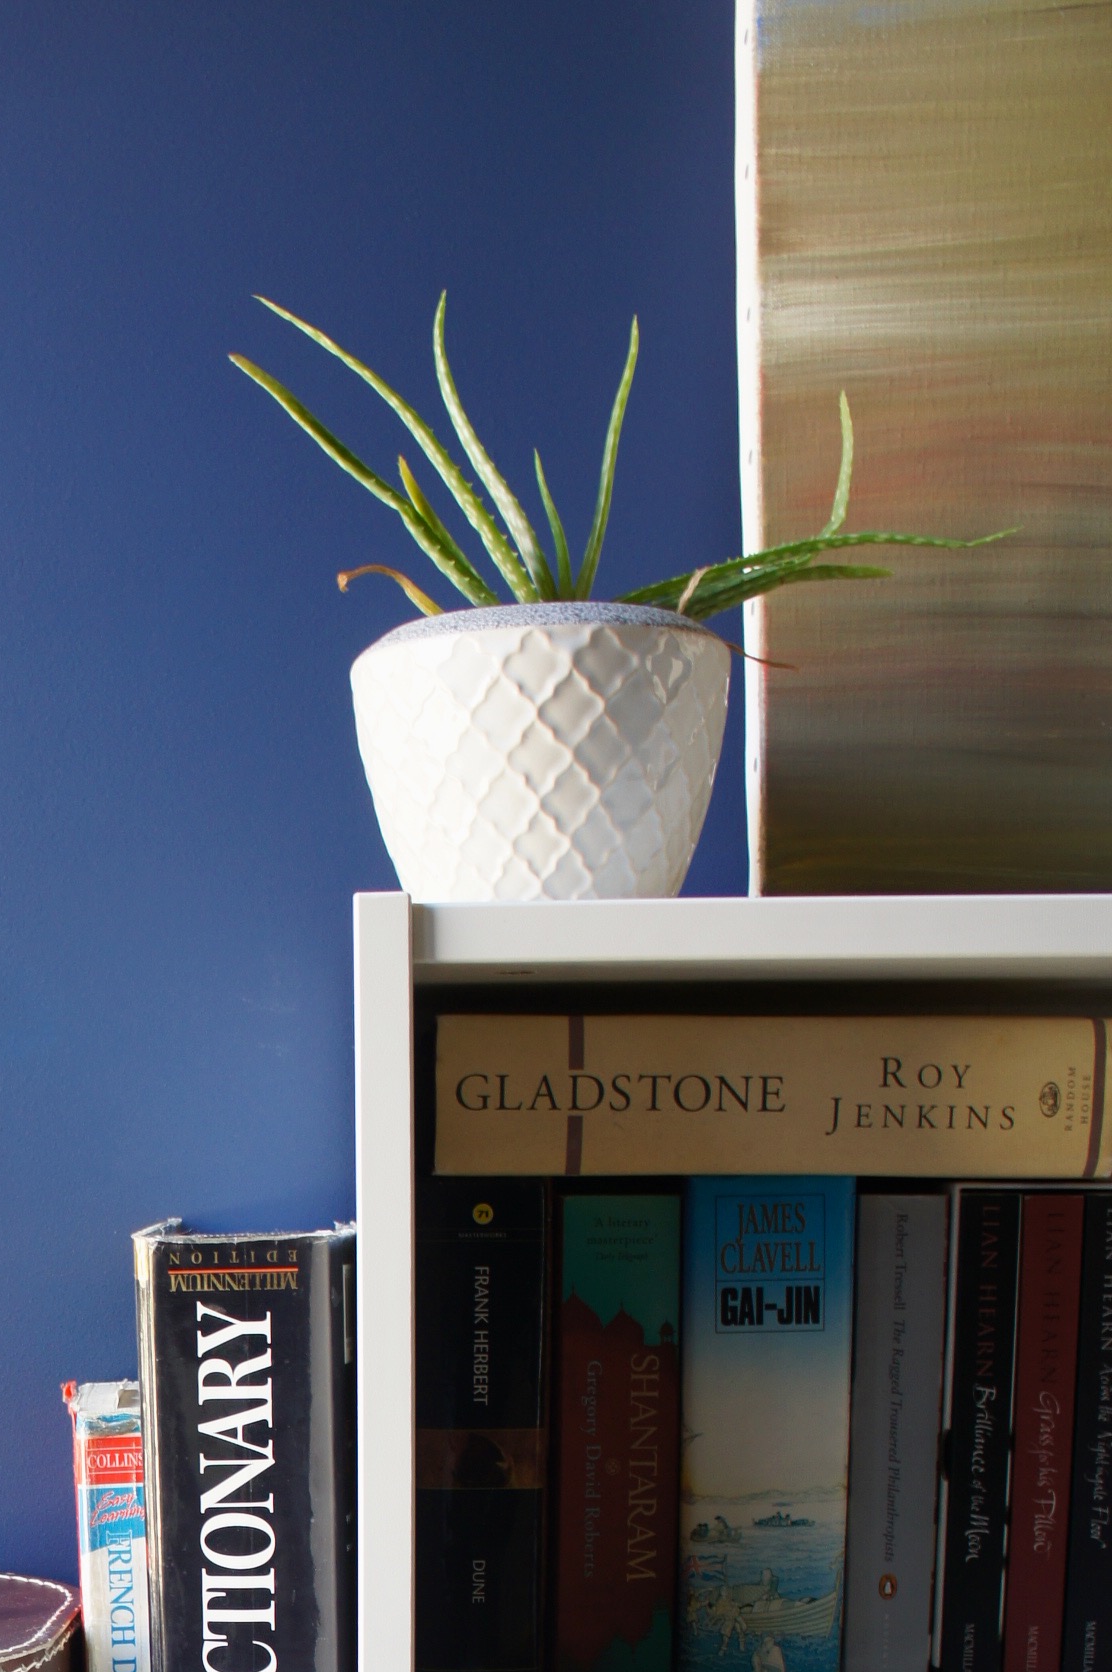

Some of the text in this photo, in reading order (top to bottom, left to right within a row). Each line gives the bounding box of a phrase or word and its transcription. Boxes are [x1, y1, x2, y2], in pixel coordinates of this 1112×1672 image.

[455, 1073, 788, 1113] GLADSTONE
[879, 1057, 974, 1090] ROY
[825, 1096, 1017, 1136] JENKINS
[1064, 1066, 1076, 1132] RANDOM
[1081, 1075, 1091, 1125] HOUSE
[736, 1201, 807, 1243] JAMES
[1047, 1212, 1066, 1274] LIAN
[169, 1250, 298, 1265] EDITION
[720, 1239, 821, 1274] CLAVELL
[169, 1271, 299, 1293] MILLENNIUM
[720, 1286, 820, 1326] GAI-JIN
[473, 1266, 490, 1406] FRANK HERBERT
[1040, 1291, 1061, 1384] HEARN
[883, 1213, 909, 1563] Robert Tressell The Ragged Trousered Philanthropists
[964, 1205, 1001, 1563] LIAN HEARN Brilliance of the Moon
[1032, 1390, 1061, 1447] Grass
[88, 1452, 143, 1469] COLLINS
[580, 1360, 603, 1578] Gregory David Roberts
[626, 1353, 660, 1583] SHANTARAM
[1028, 1441, 1055, 1466] for
[1083, 1430, 1112, 1500] Nightingale
[1037, 1467, 1058, 1488] his
[90, 1503, 146, 1528] Learning
[97, 1490, 137, 1511] Easy
[1090, 1504, 1111, 1549] Floor
[106, 1529, 137, 1648] FRENCH
[471, 1559, 487, 1604] DUNE
